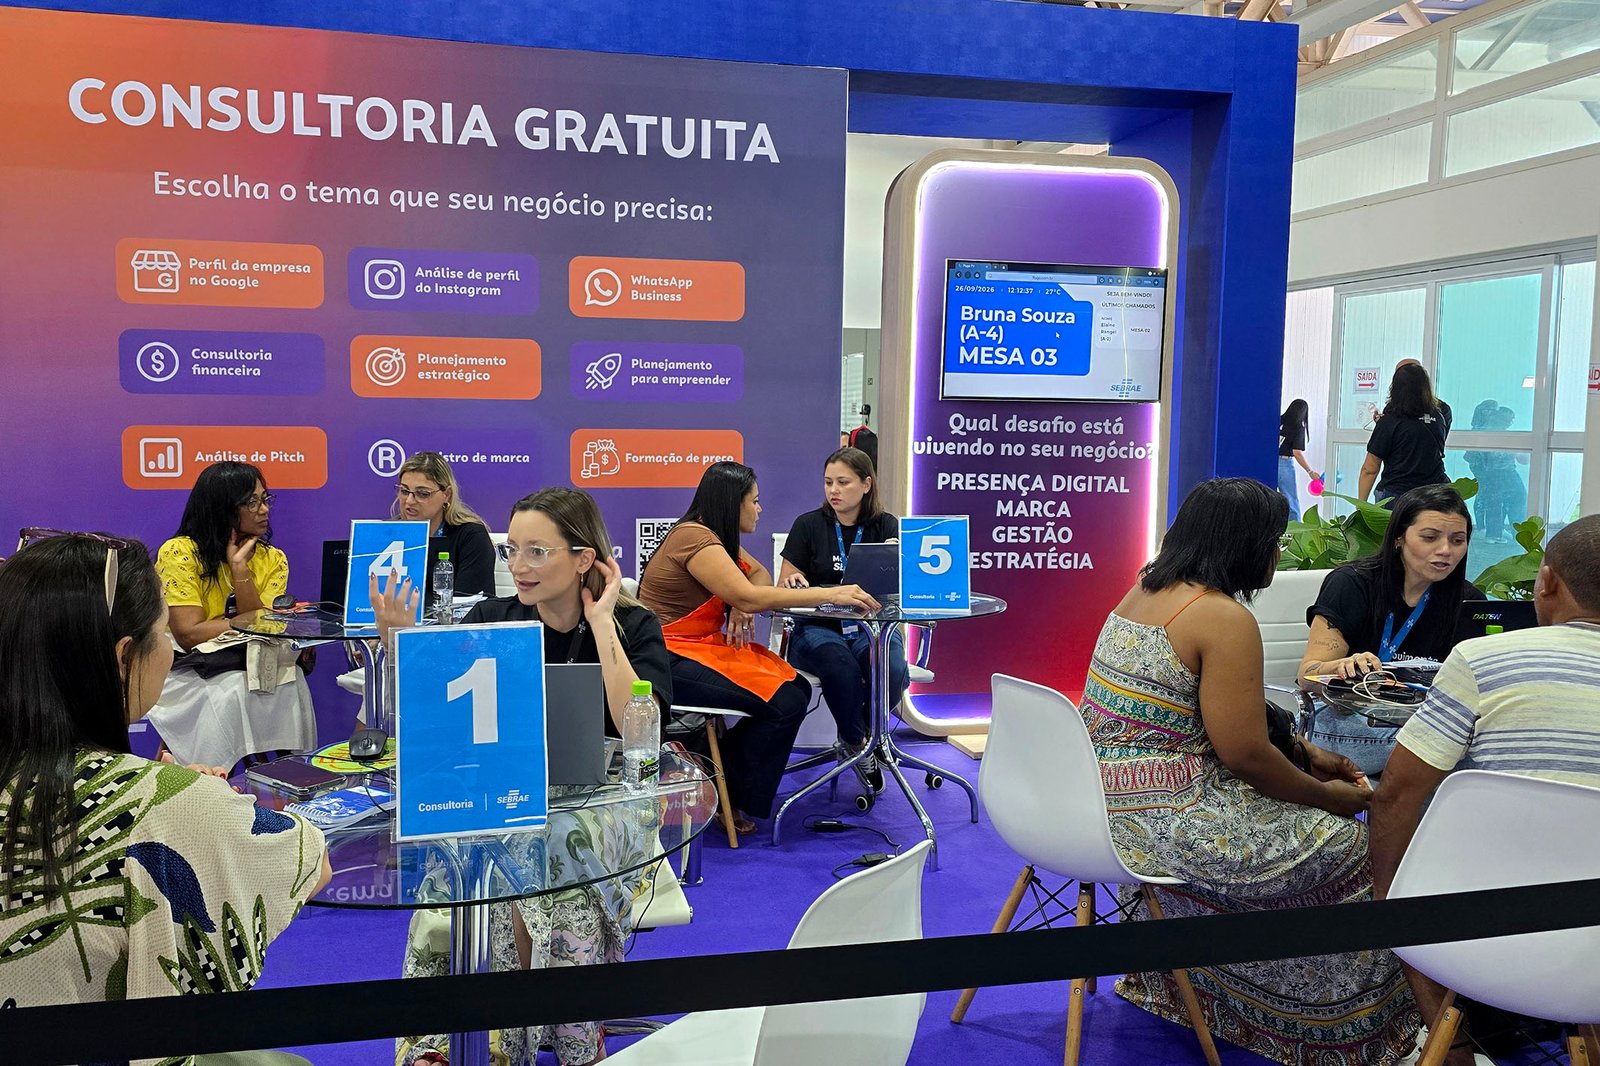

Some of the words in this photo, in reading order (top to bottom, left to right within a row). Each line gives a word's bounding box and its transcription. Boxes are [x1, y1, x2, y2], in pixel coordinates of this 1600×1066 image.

[68, 78, 498, 147] CONSULTORIA
[514, 107, 780, 164] GRATUITA
[154, 171, 269, 200] Escolha
[279, 181, 297, 201] o
[306, 181, 379, 205] tema
[389, 189, 439, 213] que
[448, 191, 494, 211] seu
[503, 191, 605, 220] negócio
[614, 197, 713, 223] precisa:
[189, 258, 227, 271] Perfil
[231, 259, 249, 272] da
[252, 261, 311, 275] empresa
[415, 266, 464, 279] Análise
[467, 268, 483, 280] de
[486, 270, 520, 283] perfil
[189, 276, 207, 286] no
[211, 275, 259, 289] Google
[415, 282, 431, 293] do
[435, 283, 501, 297] Instagram
[631, 275, 693, 290] WhatsApp
[955, 285, 995, 293] 26/09/2026
[631, 290, 682, 302] Business
[961, 305, 1016, 322] Bruna
[1021, 308, 1075, 324] Souza
[960, 325, 1004, 343] (A-4)
[191, 348, 272, 361] Consultoria
[417, 353, 507, 367] Planejamento
[959, 346, 1024, 366] MESA
[1031, 348, 1058, 366] 03
[192, 364, 261, 376] financeira
[631, 358, 712, 372] Planejamento
[417, 369, 491, 383] estratégico
[631, 376, 659, 387] para
[662, 374, 731, 387] empreender
[1357, 371, 1377, 381] SAÍDA
[1110, 384, 1142, 392] SEBRAE
[949, 412, 998, 436] Qual
[1005, 414, 1076, 435] desafio
[1081, 416, 1124, 435] está
[195, 450, 247, 462] Análise
[250, 451, 266, 462] de
[270, 451, 305, 463] Pitch
[472, 452, 487, 463] de
[490, 454, 530, 463] marca
[913, 436, 995, 456] vivendo
[1000, 441, 1025, 457] no
[1031, 443, 1064, 458] seu
[1071, 440, 1154, 463] negócio?
[625, 453, 683, 466] Formação
[686, 453, 700, 463] de
[937, 473, 1045, 496] PRESENÇA
[1052, 475, 1129, 493] DIGITAL
[996, 500, 1071, 518] MARCA
[992, 522, 1073, 544] GESTÃO
[369, 541, 408, 584] 4
[918, 535, 953, 575] 5
[970, 547, 1094, 570] ESTRATÉGIA
[447, 657, 498, 745] 1
[418, 799, 474, 813] Consultoria
[496, 794, 530, 805] SEBRAE
